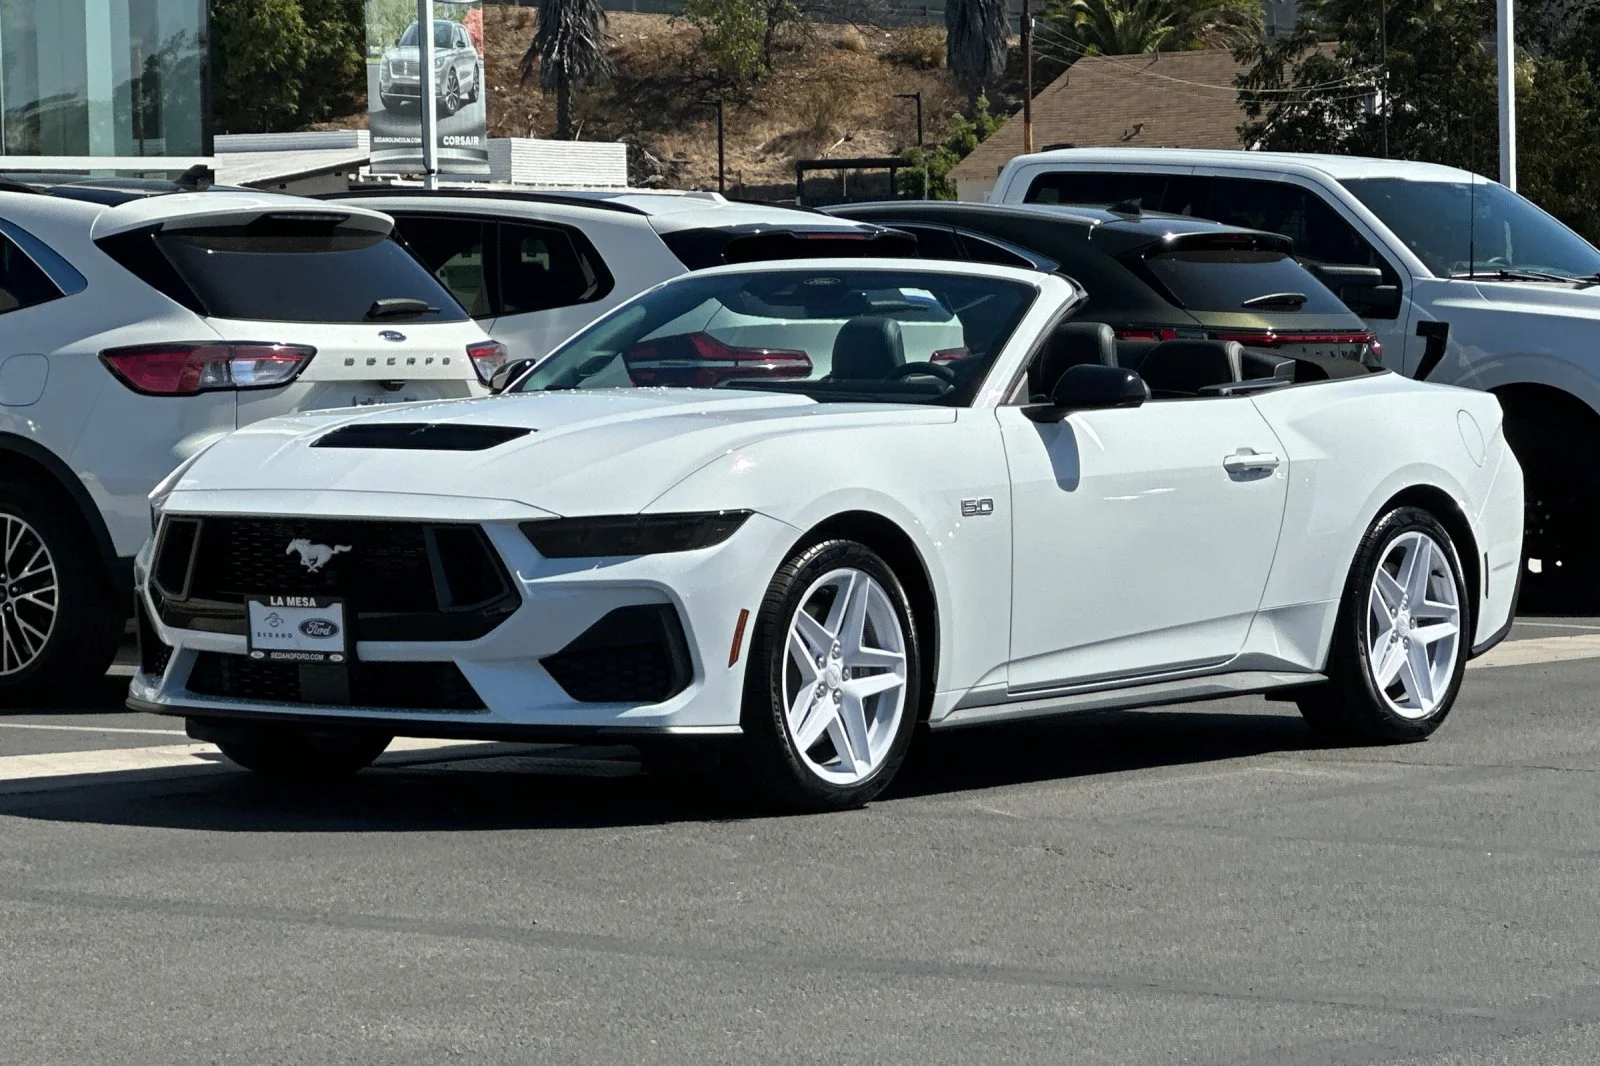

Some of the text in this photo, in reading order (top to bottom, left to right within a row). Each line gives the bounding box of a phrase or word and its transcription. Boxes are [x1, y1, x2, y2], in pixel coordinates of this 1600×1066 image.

[443, 135, 480, 146] CORSAIR
[961, 499, 993, 517] 5.0
[270, 596, 317, 607] LA MESA
[270, 652, 324, 661] SEDANOFORD.COM
